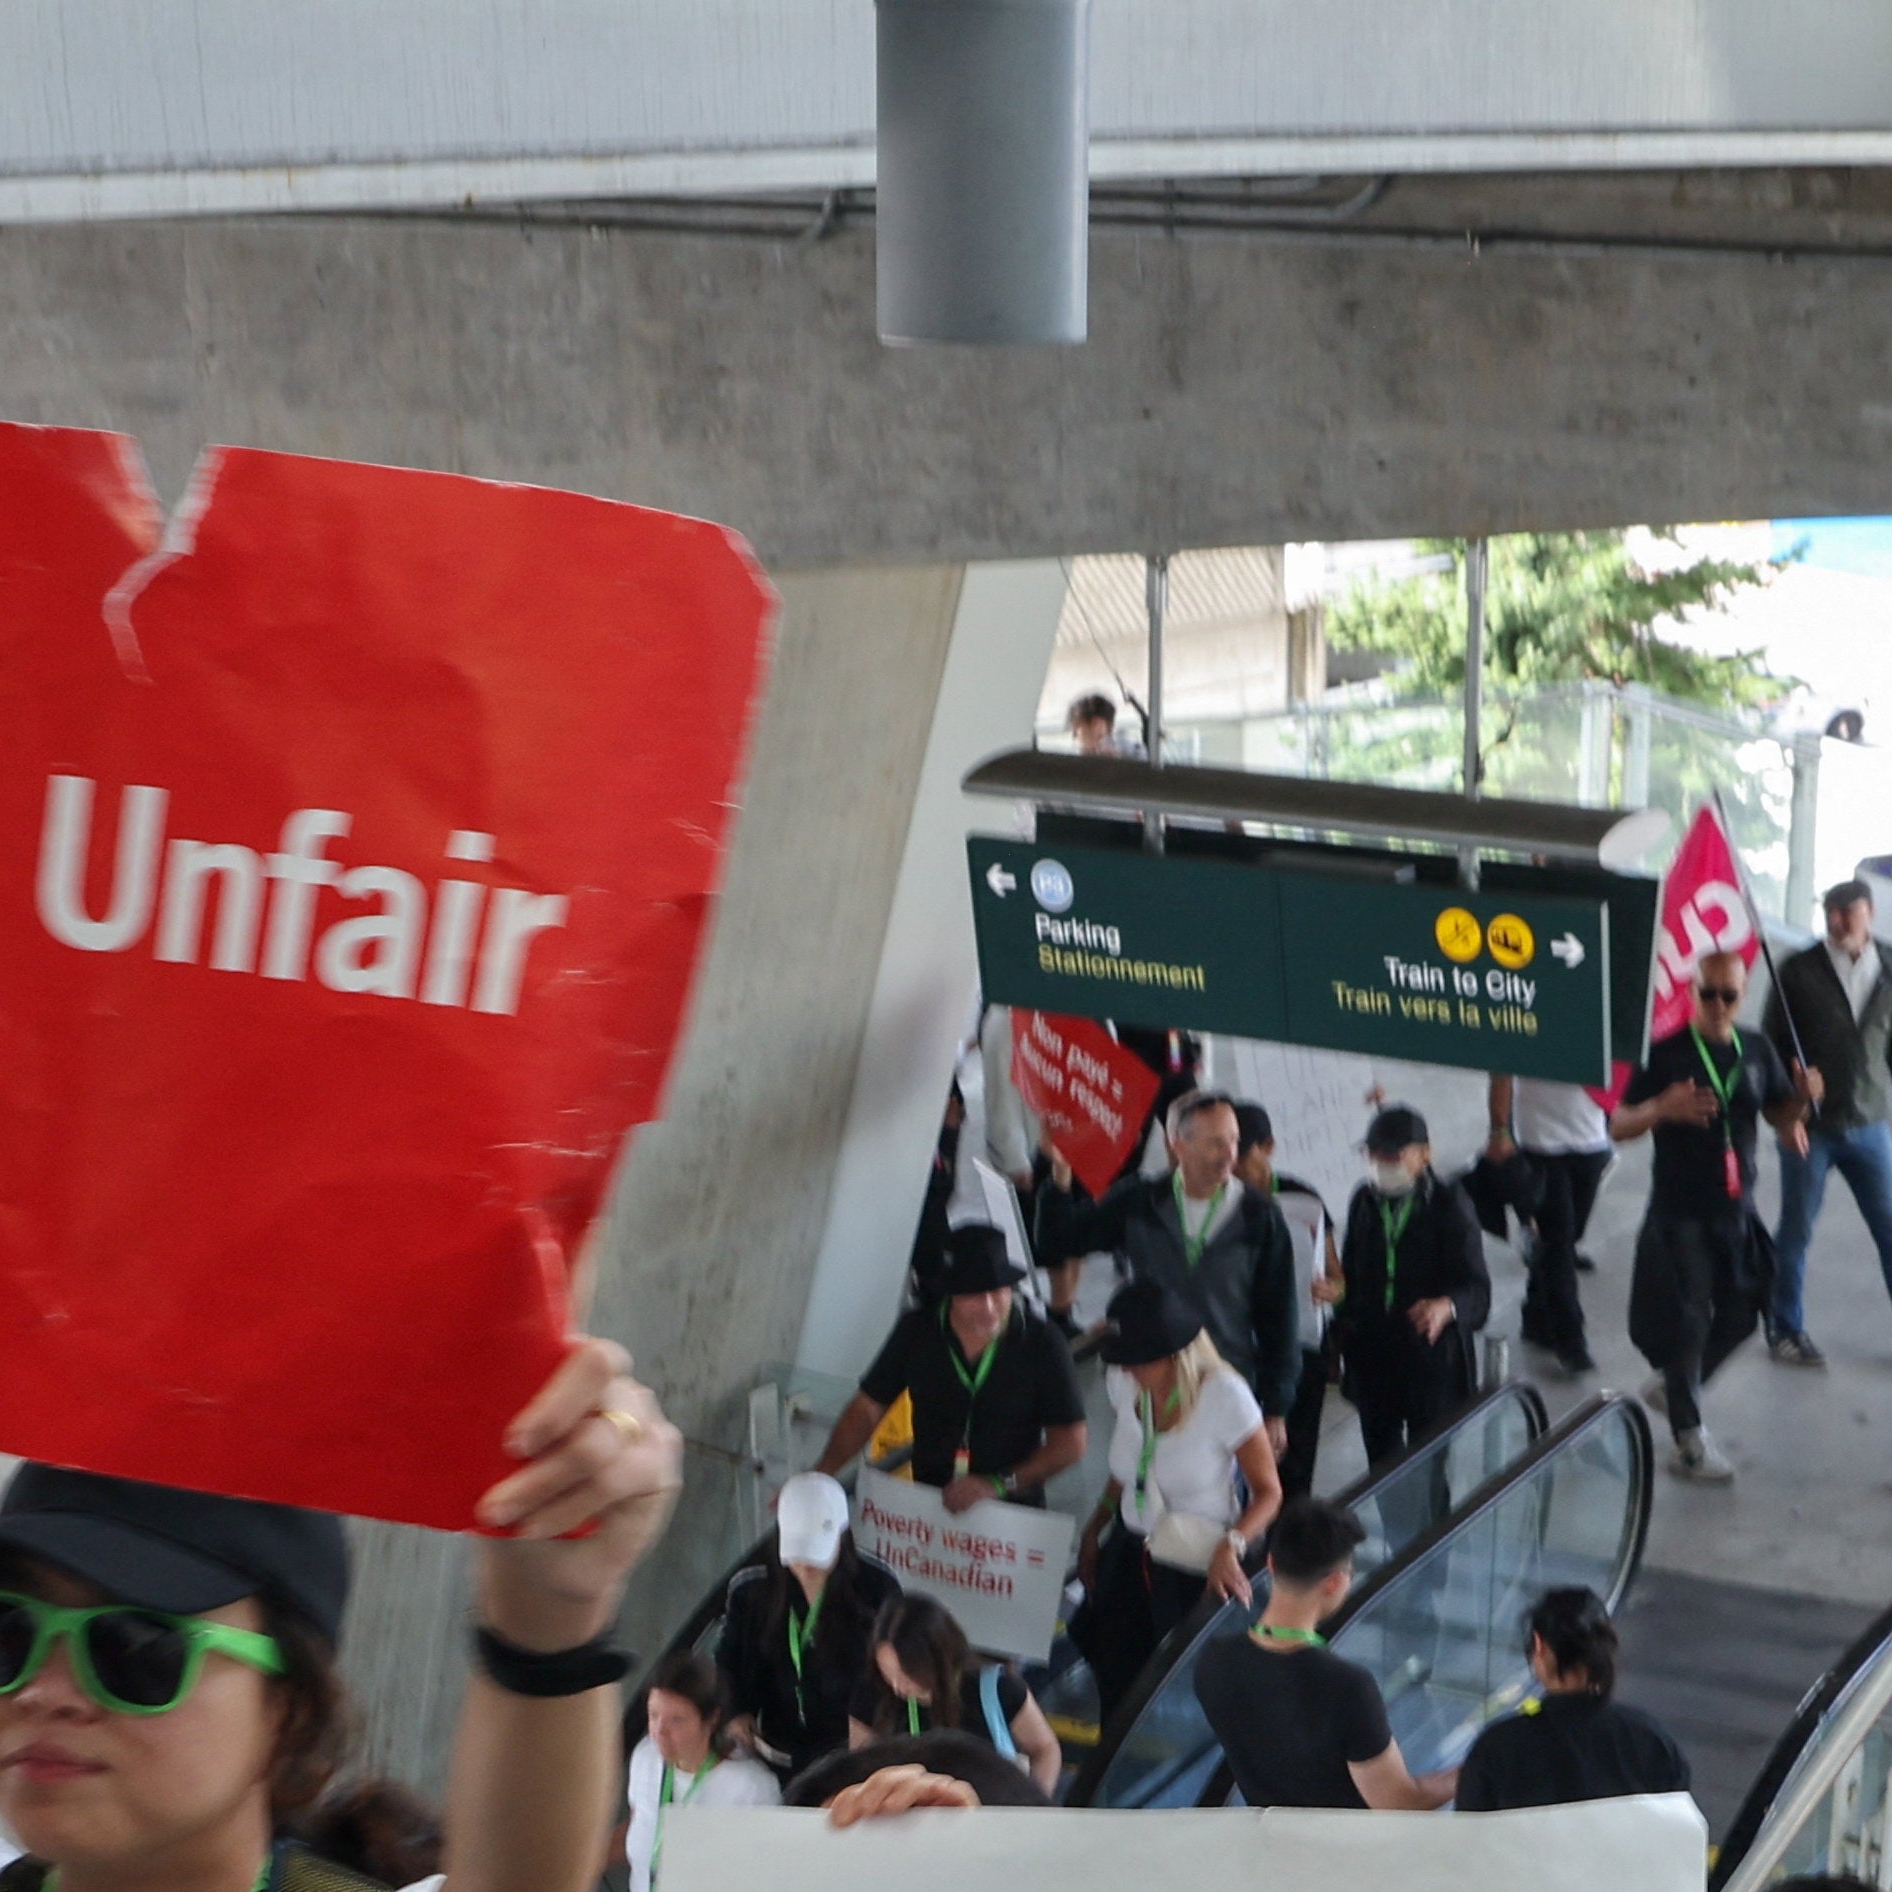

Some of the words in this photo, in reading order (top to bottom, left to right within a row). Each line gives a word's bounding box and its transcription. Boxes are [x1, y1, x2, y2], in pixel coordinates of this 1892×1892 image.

[36, 773, 570, 1017] Unfair
[1035, 911, 1122, 957] Parking
[1038, 942, 1206, 992] Stationnement
[1383, 954, 1445, 994] Train
[1452, 965, 1478, 999] to
[1486, 969, 1537, 1010] City
[1331, 980, 1391, 1018] Train
[1400, 994, 1451, 1025] vers
[1459, 998, 1481, 1030] la
[1488, 1004, 1539, 1037] ville
[861, 1498, 934, 1547] Poverty
[941, 1526, 1017, 1563] wages
[874, 1536, 1016, 1598] UnCanadian
